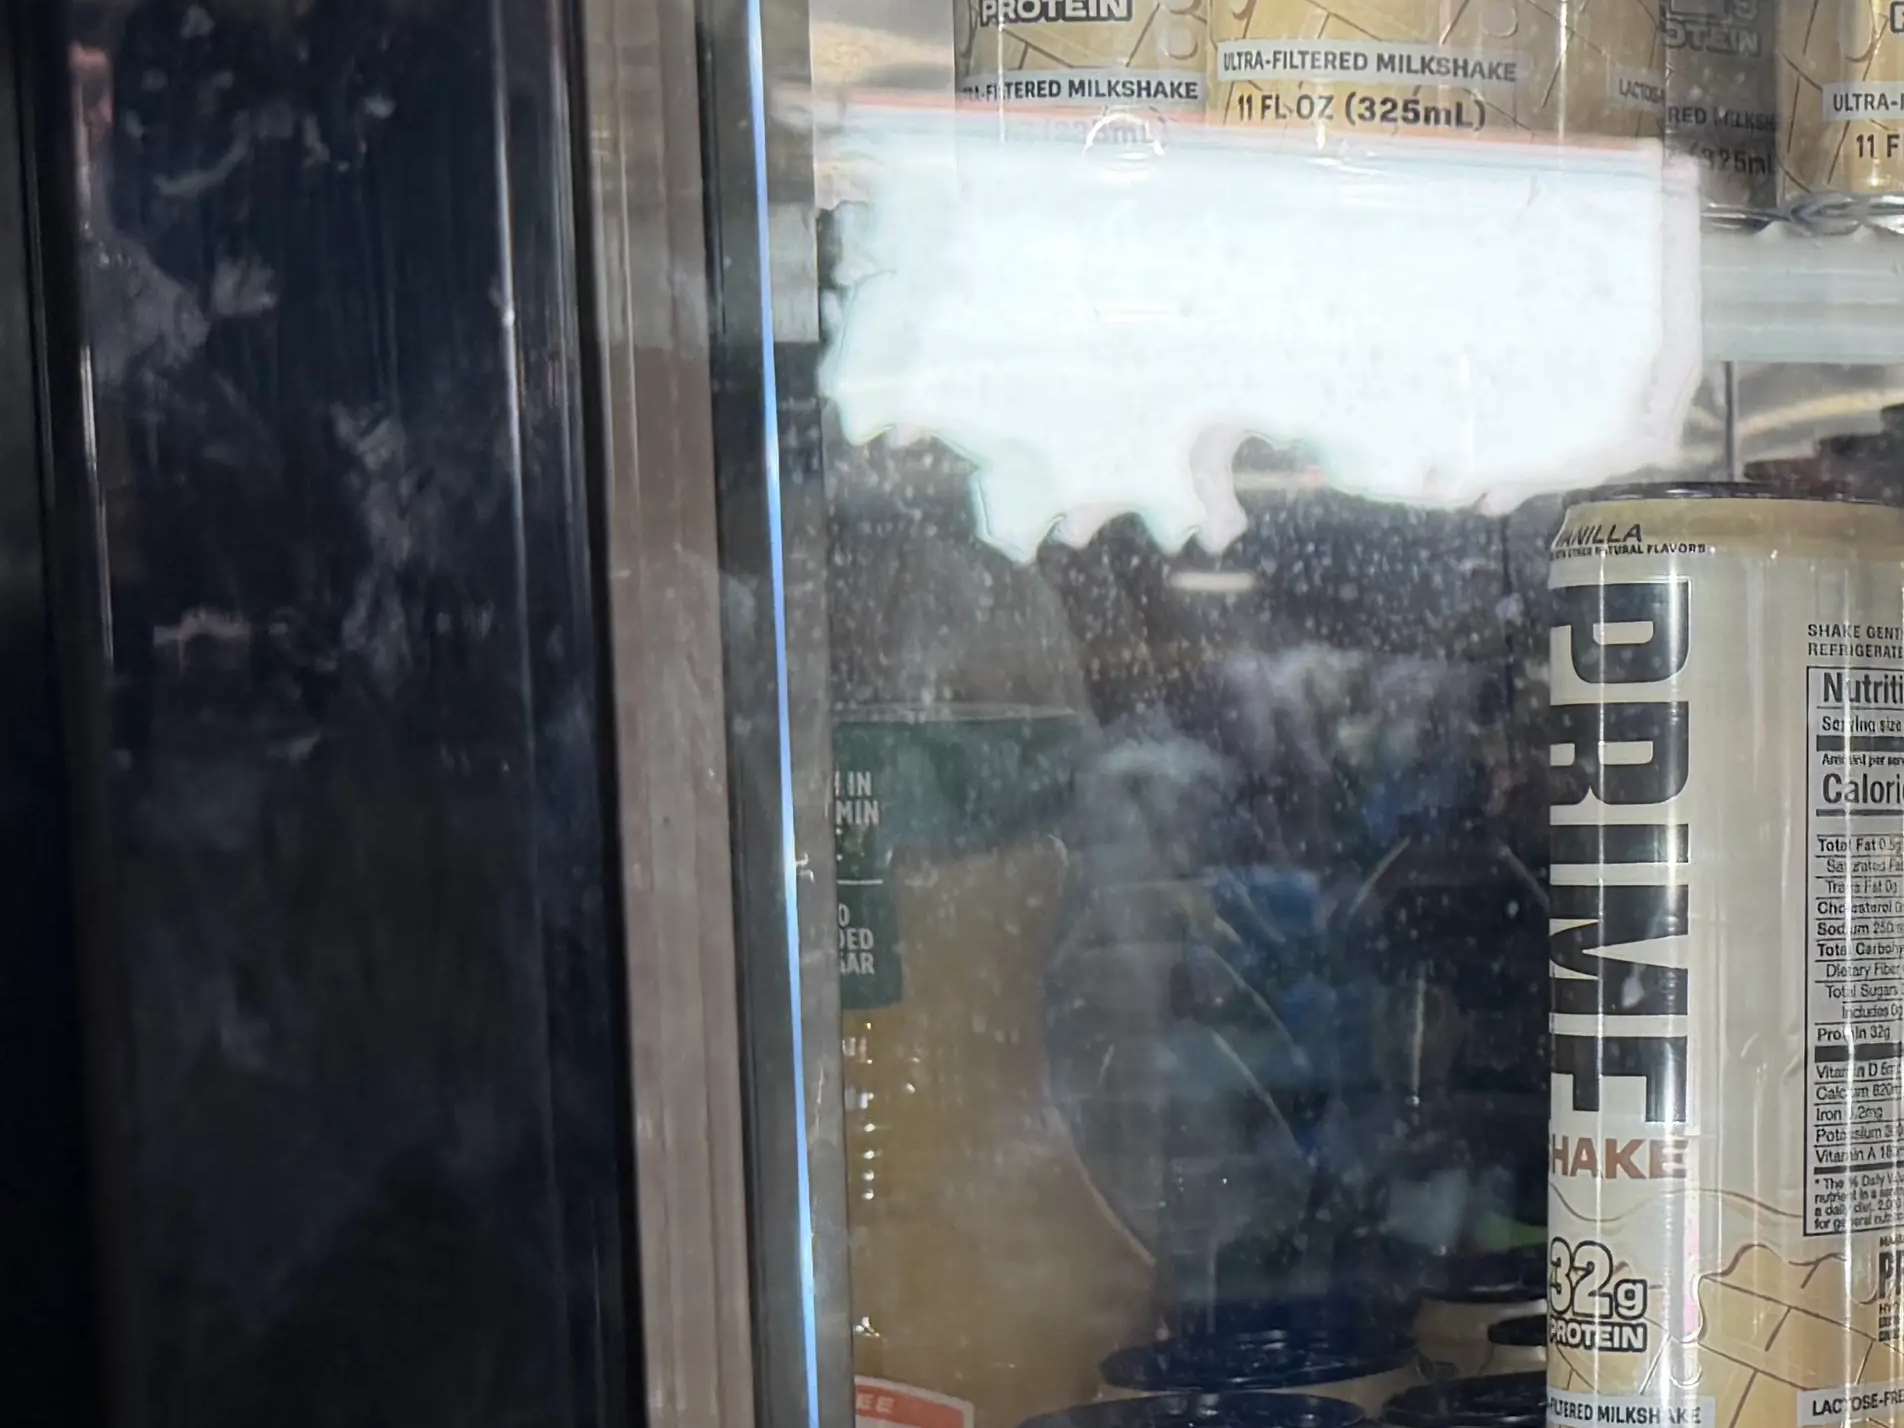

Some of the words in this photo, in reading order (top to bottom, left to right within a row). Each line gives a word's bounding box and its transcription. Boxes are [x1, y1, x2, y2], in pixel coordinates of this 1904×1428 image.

[1222, 47, 1370, 74] ULTRA-FILTERED
[1376, 51, 1518, 82] MILKSHAKE
[847, 771, 873, 797] IN
